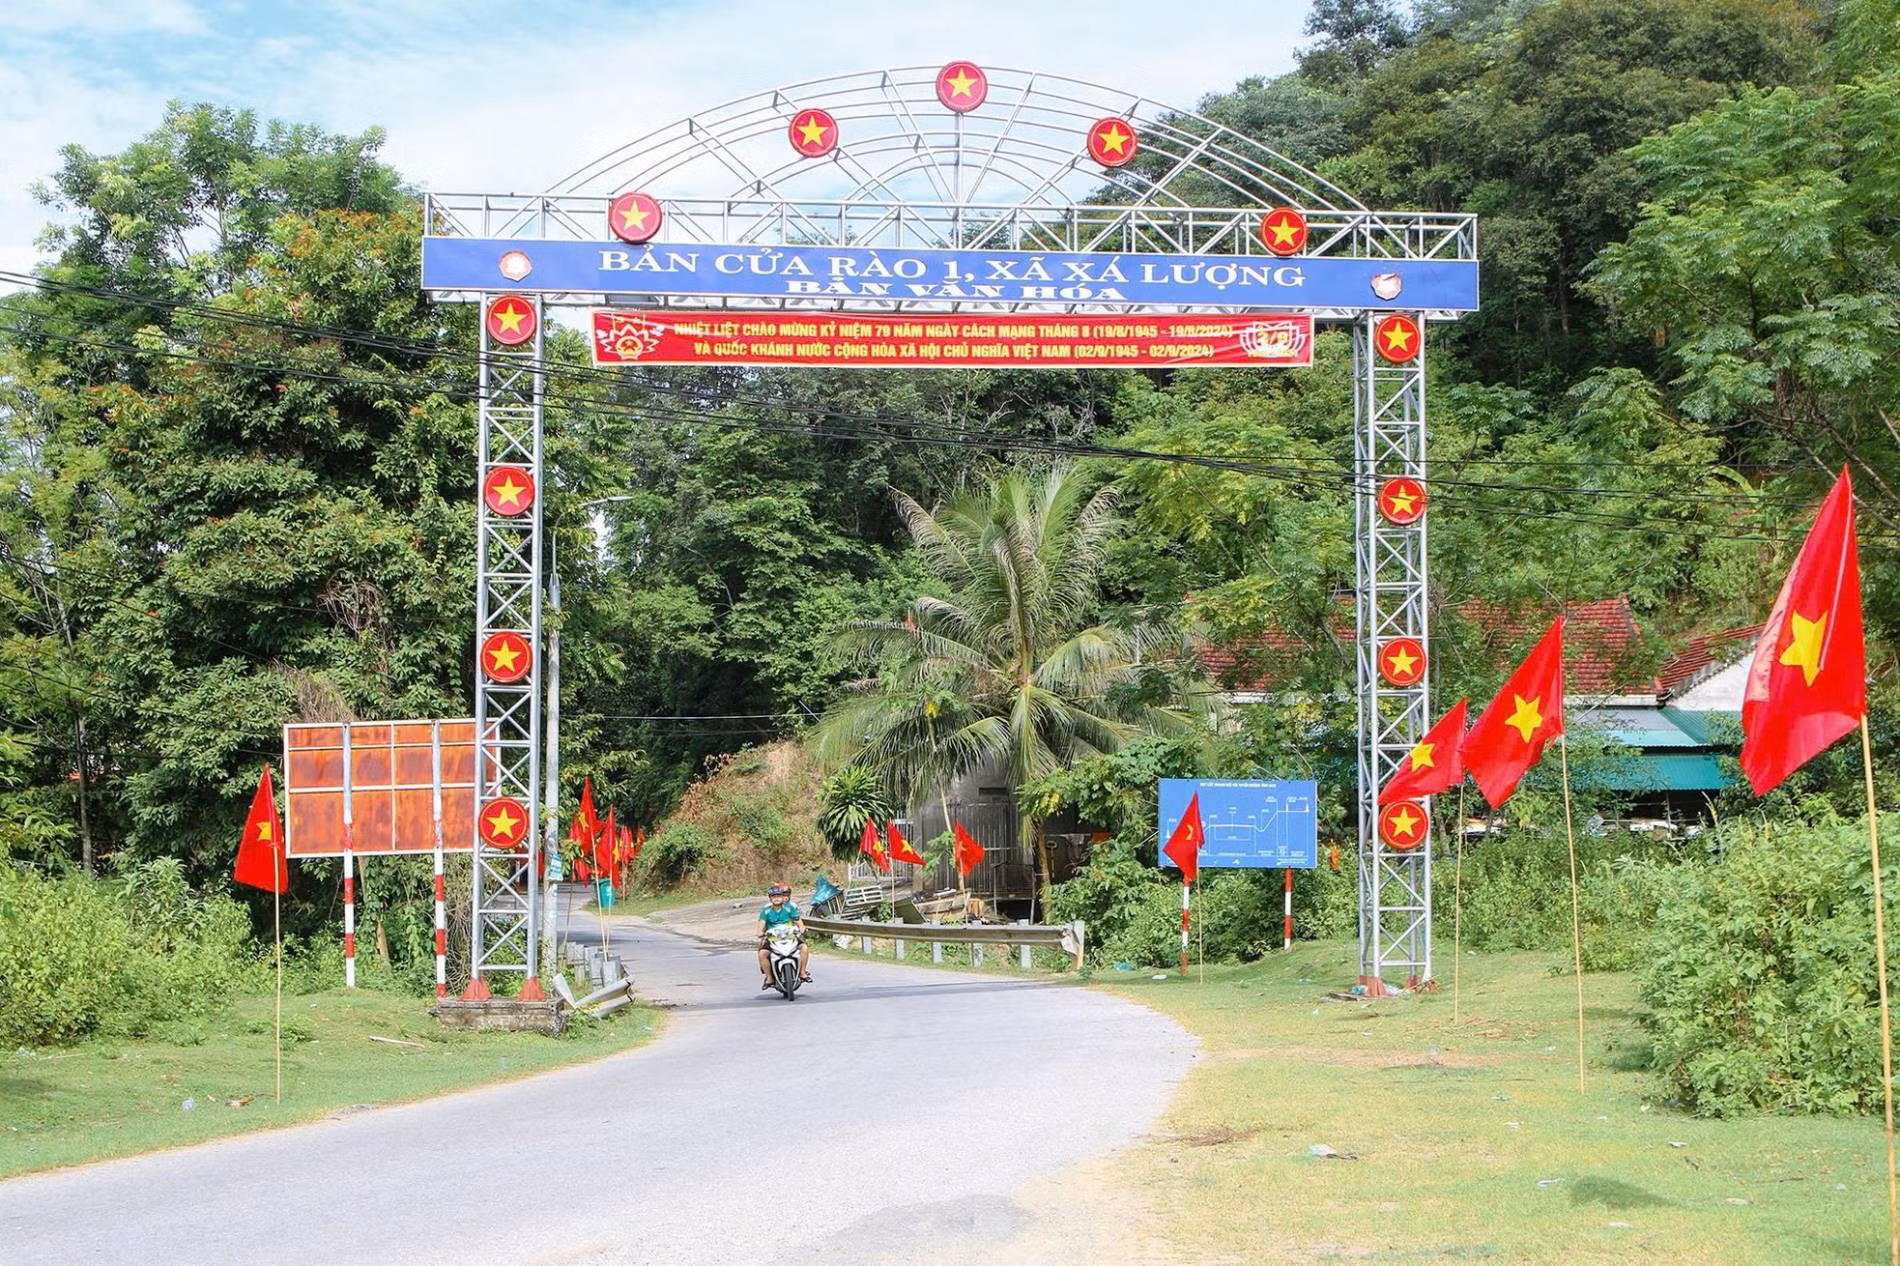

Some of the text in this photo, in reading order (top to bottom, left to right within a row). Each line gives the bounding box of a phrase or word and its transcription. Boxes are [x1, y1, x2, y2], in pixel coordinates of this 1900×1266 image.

[598, 245, 1306, 290] BẢN CỬA RÀO 1, XÃ XÁ LƯỢNG
[785, 277, 1127, 300] BẢN VĂN HÓA
[674, 321, 712, 338] NHIỆT
[714, 321, 739, 338] LIỆT
[742, 321, 776, 336] CHÀO
[780, 321, 817, 337] MỪNG
[820, 320, 836, 337] KỶ
[839, 321, 872, 339] NIỆM
[876, 324, 890, 338] 79
[893, 322, 923, 338] NĂM
[926, 322, 958, 338] NGÀY
[962, 322, 996, 338] CÁCH
[998, 324, 1036, 340] MẠNG
[1039, 323, 1079, 338] THÁNG
[1081, 324, 1090, 338] 8
[1093, 325, 1158, 339] (19/8/1945
[694, 341, 710, 356] VÀ
[713, 339, 747, 356] QUỐC
[751, 340, 793, 357] KHÁNH
[797, 341, 831, 357] NƯỚC
[834, 341, 867, 359] CỘNG
[871, 341, 896, 357] HÒA
[899, 341, 917, 357] XÃ
[920, 341, 941, 359] HỘI
[943, 341, 968, 358] CHỦ
[971, 342, 1010, 358] NGHĨA
[1012, 343, 1039, 360] VIỆT
[1041, 344, 1071, 358] NAM
[1074, 344, 1139, 359] (02/9/1945
[1149, 344, 1214, 358] 02/9/2024)
